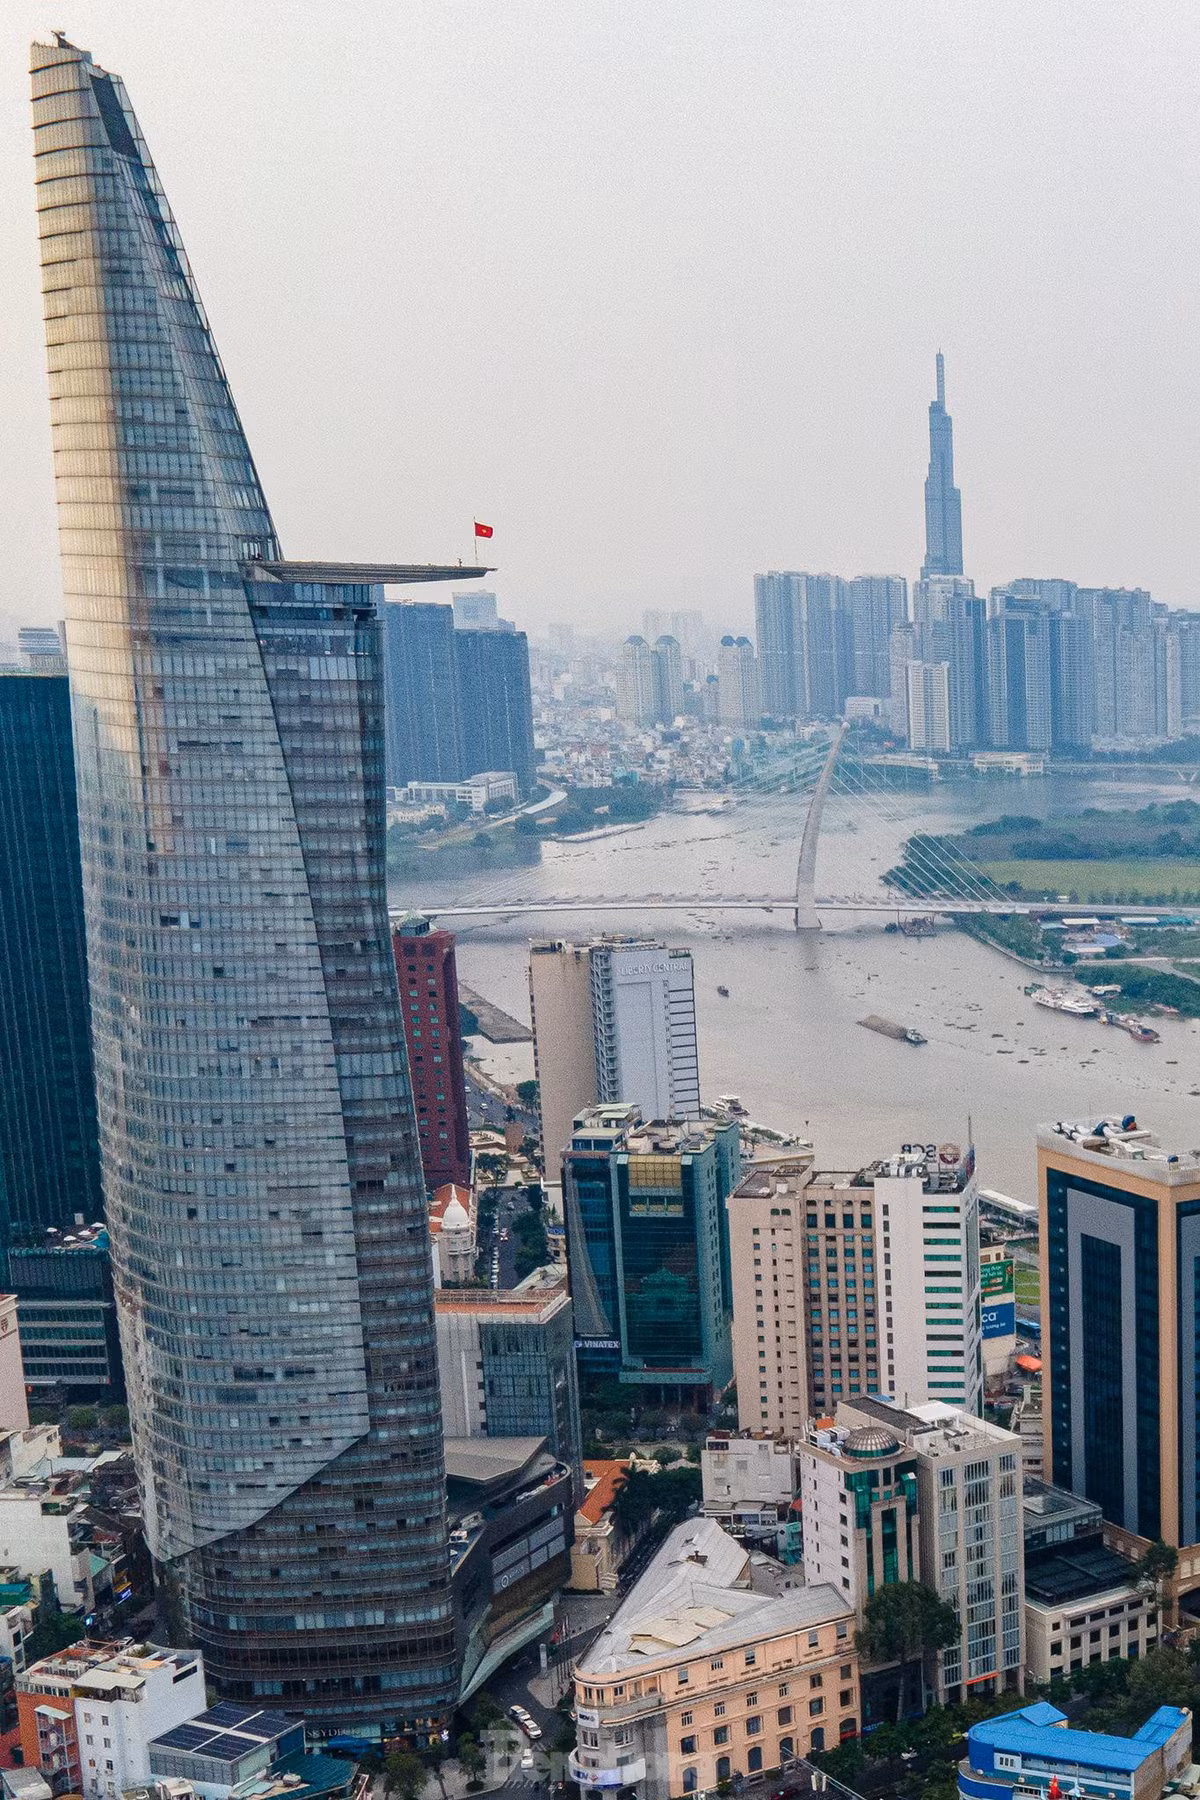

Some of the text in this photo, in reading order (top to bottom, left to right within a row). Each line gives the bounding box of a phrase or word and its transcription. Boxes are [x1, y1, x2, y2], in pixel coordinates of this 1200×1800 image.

[621, 962, 689, 976] LIBERTY CENTRAL
[584, 1340, 620, 1349] VINATEX
